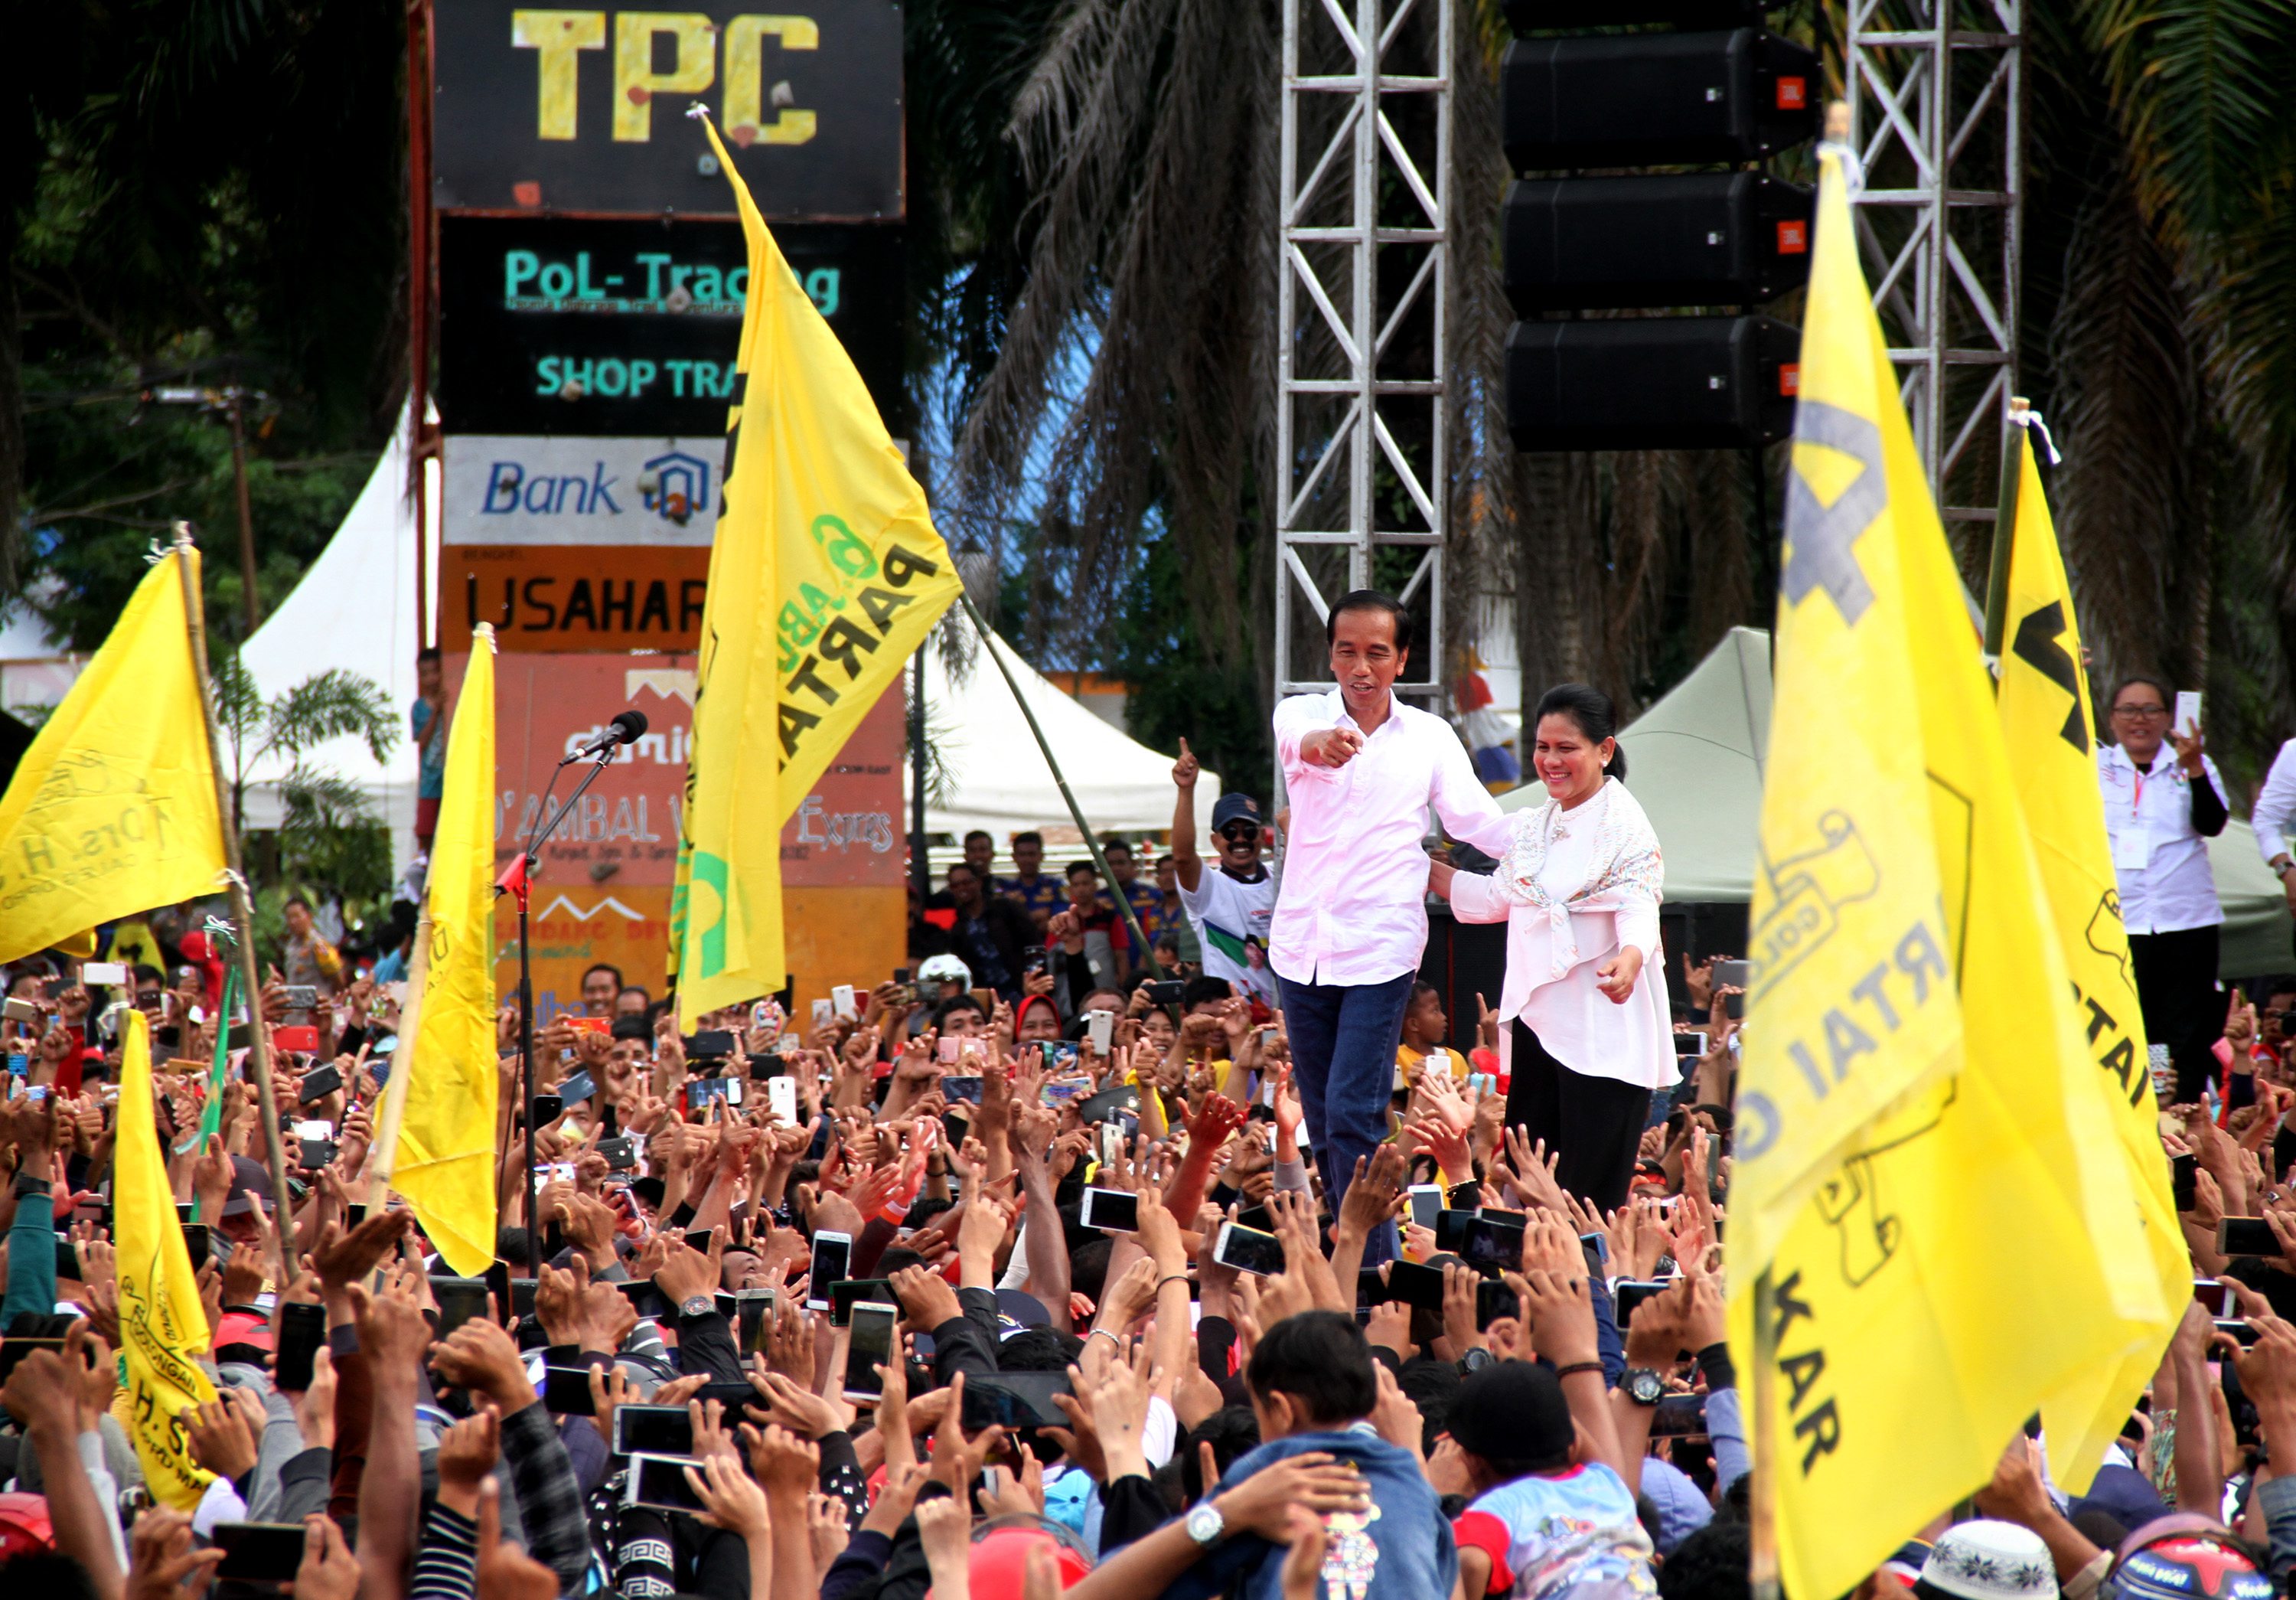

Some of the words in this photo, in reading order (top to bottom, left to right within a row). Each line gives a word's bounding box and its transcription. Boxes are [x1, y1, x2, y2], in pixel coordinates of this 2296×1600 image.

[511, 9, 819, 145] TPC
[536, 356, 657, 397] SHOP
[481, 461, 625, 514] Bank
[797, 795, 894, 853] Expres
